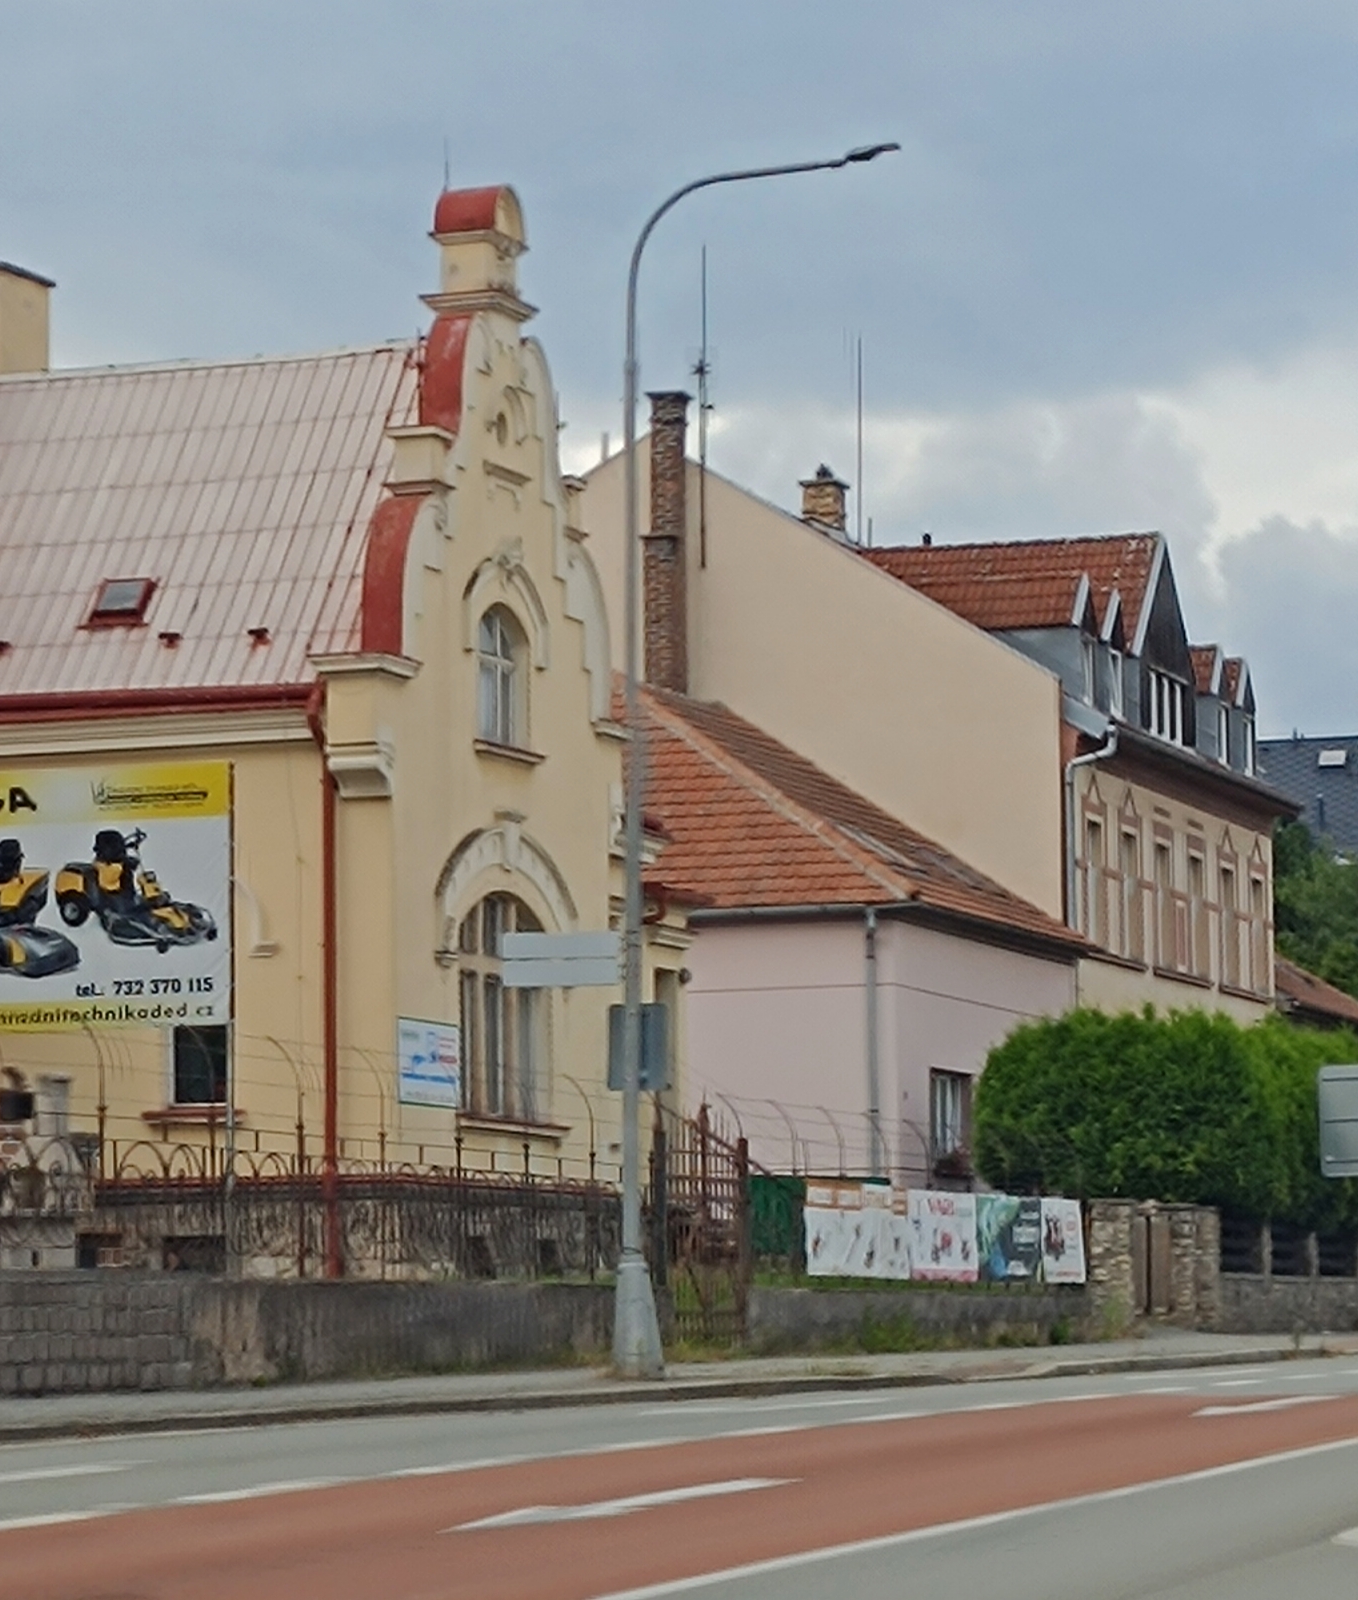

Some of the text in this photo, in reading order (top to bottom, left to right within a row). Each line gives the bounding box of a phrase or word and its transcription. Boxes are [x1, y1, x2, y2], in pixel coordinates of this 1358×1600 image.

[113, 980, 143, 997] 732
[150, 979, 181, 995] 370
[189, 977, 213, 993] 115
